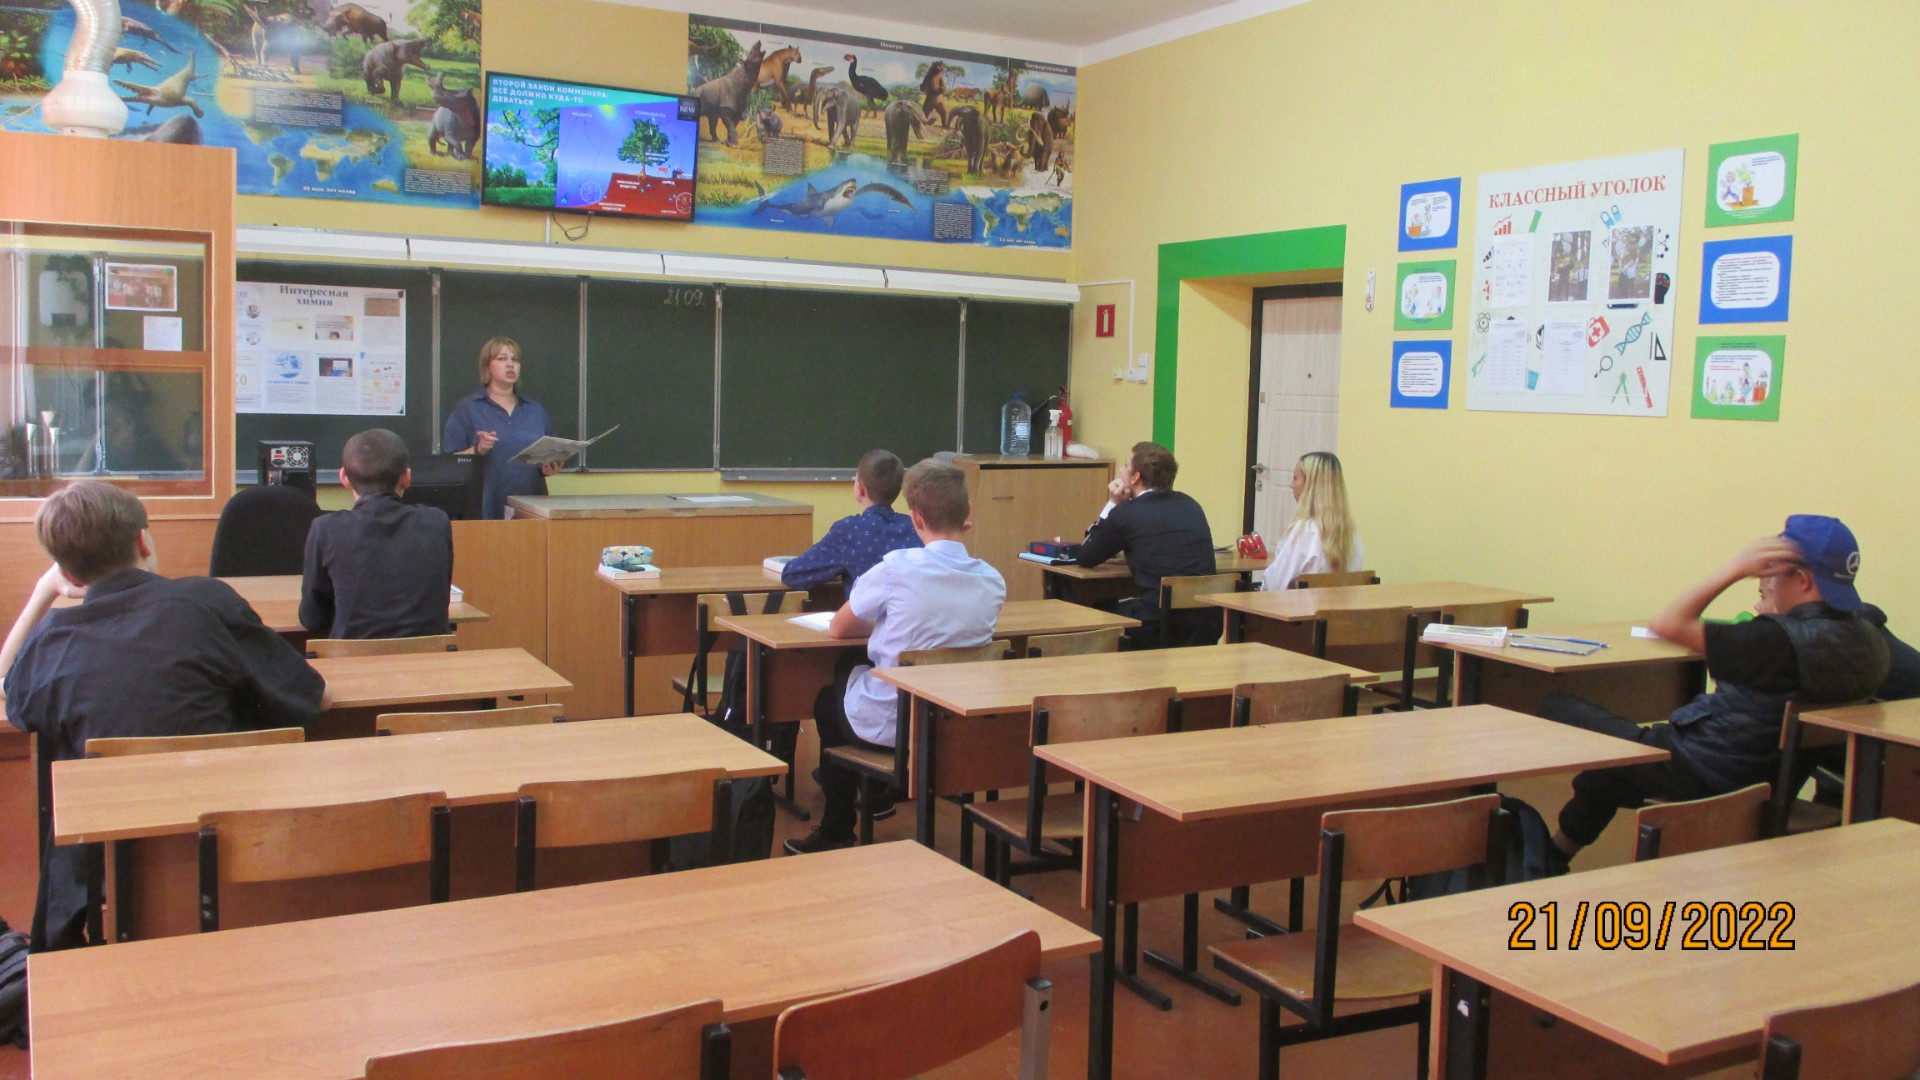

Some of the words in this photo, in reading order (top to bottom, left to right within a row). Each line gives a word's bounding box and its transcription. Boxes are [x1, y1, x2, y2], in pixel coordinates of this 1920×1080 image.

[492, 79, 526, 89] ВТОРОЙ
[528, 83, 555, 92] ЗАКОН
[492, 95, 534, 106] ДЕВАТЬСЯ
[510, 89, 547, 99] ДОЛЖНО
[549, 94, 584, 103] КУДА-ТО
[679, 105, 696, 114] NEW
[1488, 180, 1586, 208] КЛАССНЫЙ
[1591, 175, 1666, 198] УГОЛОК
[280, 285, 349, 298] Интересная
[296, 298, 333, 306] химия
